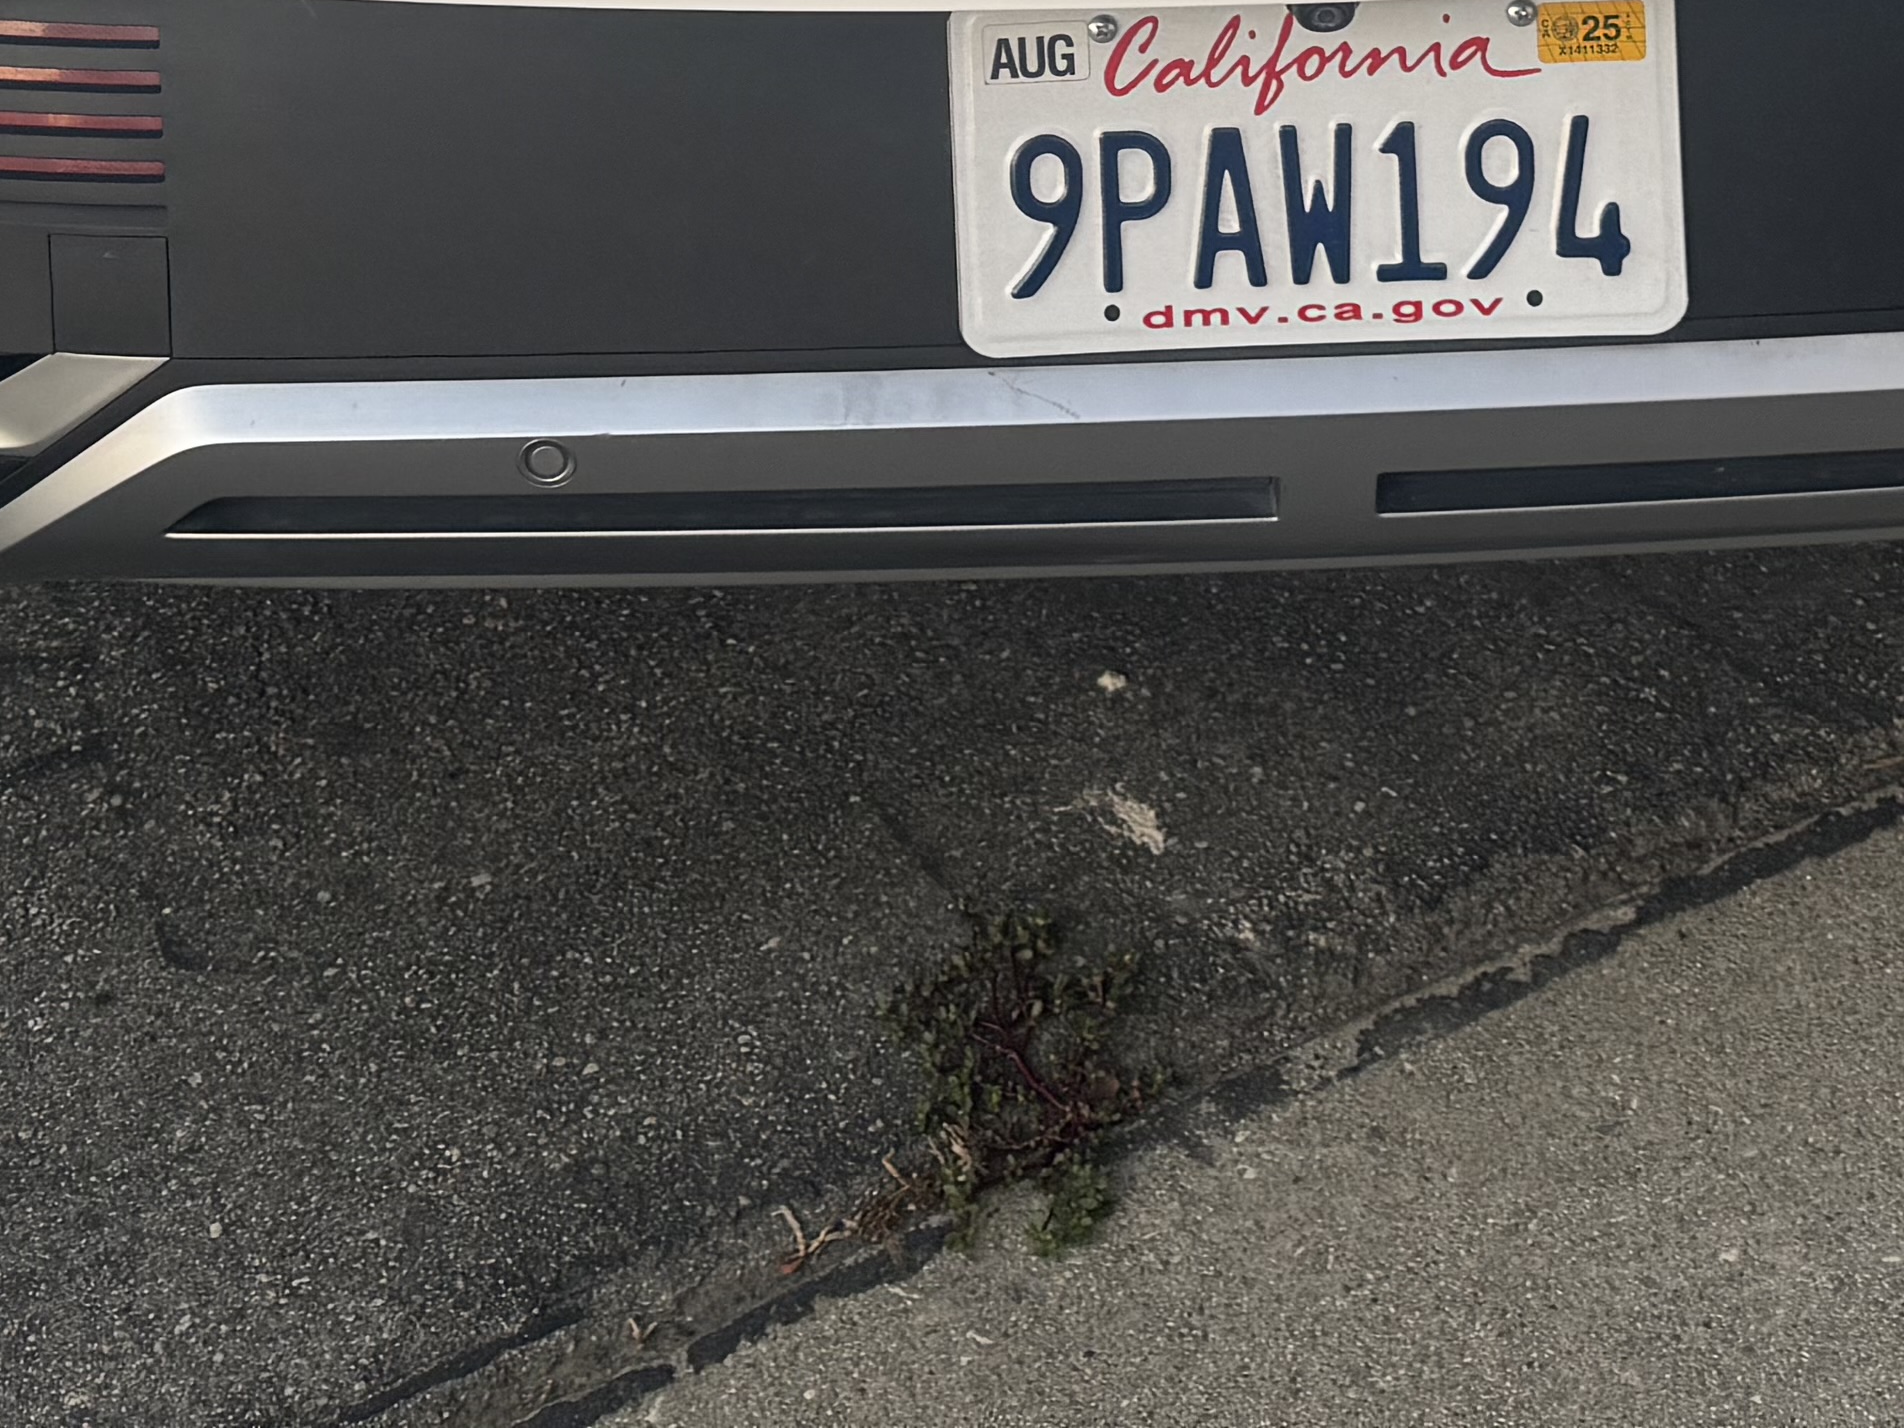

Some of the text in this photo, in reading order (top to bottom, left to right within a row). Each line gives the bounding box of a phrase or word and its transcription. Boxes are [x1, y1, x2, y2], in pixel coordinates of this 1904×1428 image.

[1581, 14, 1622, 42] 25
[990, 33, 1076, 80] AUG
[1103, 13, 1542, 116] California
[1558, 42, 1620, 56] X1411332
[1008, 114, 1632, 300] 9PAW194
[1141, 296, 1505, 330] dmv.ca.gov
